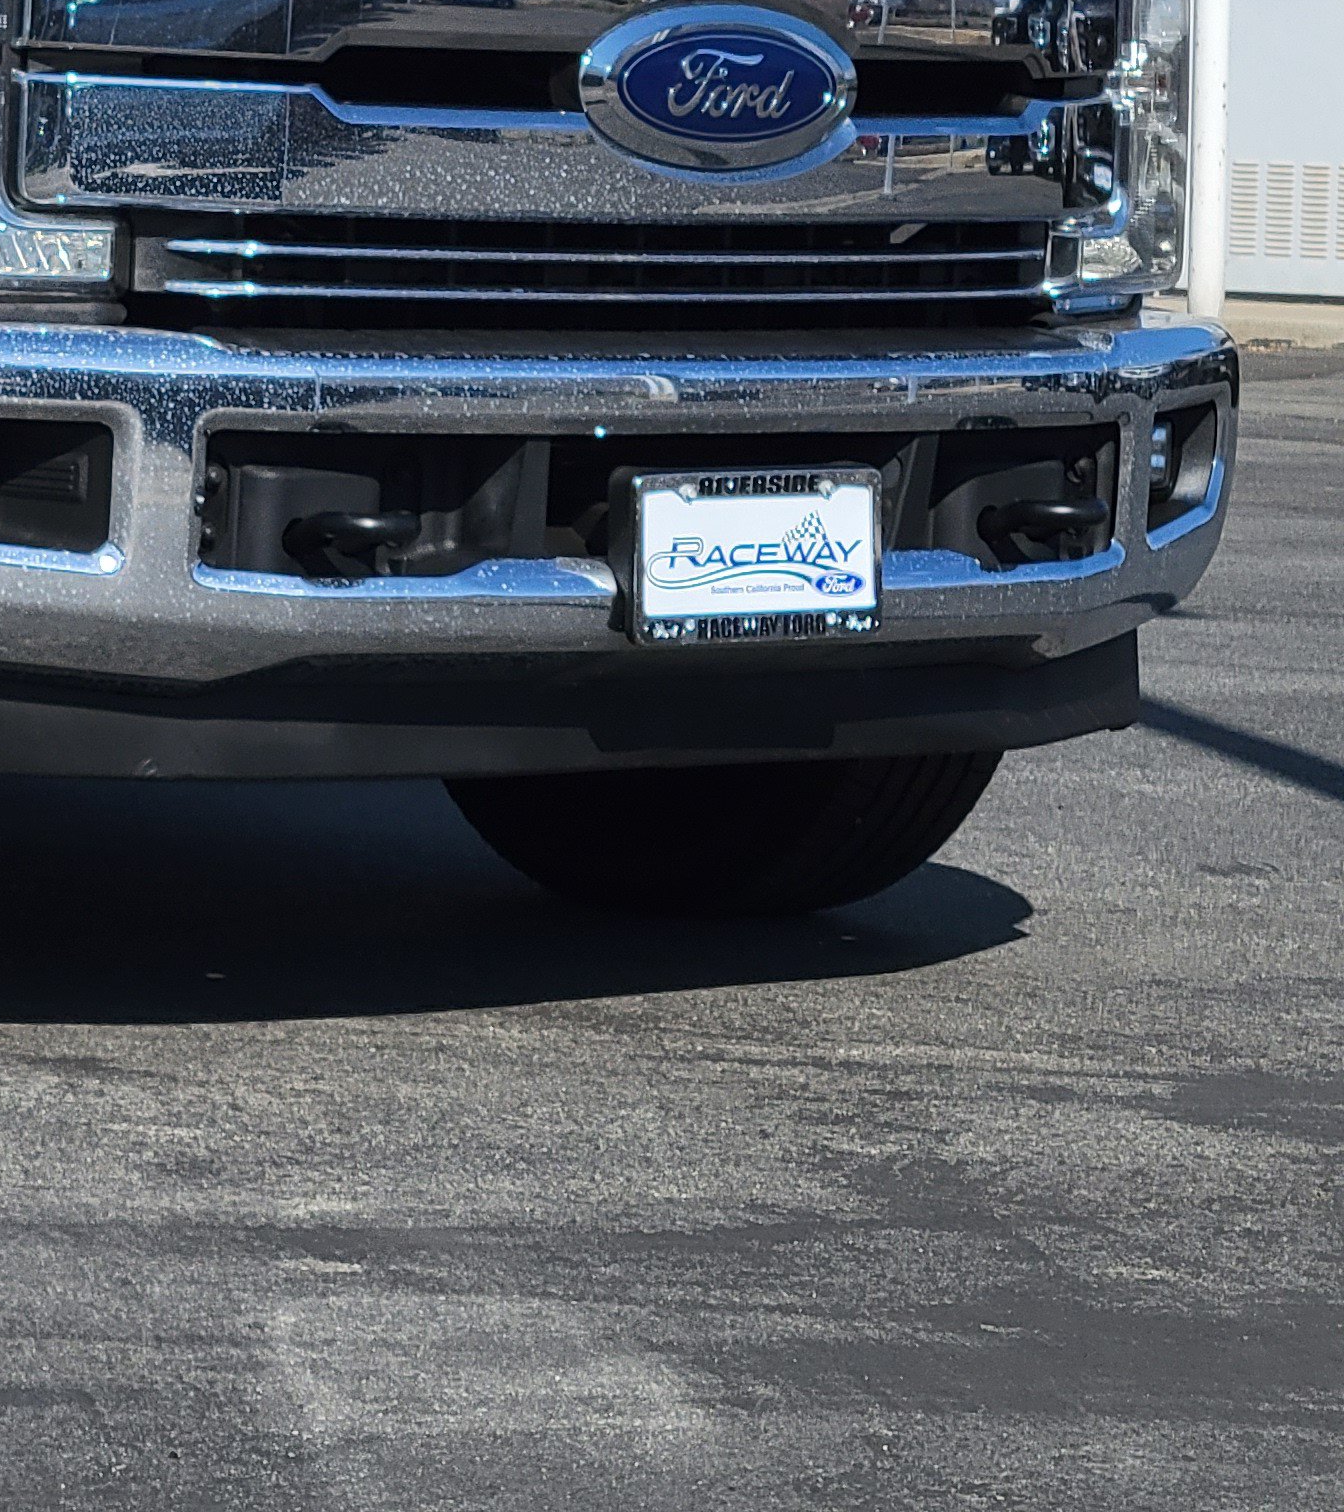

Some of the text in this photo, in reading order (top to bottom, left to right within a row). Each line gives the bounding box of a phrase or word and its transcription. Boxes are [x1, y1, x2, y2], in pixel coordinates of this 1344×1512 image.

[667, 48, 795, 120] Ford
[668, 536, 863, 570] RACEWAY
[822, 574, 857, 593] Ford
[697, 616, 778, 640] RACEWAY
